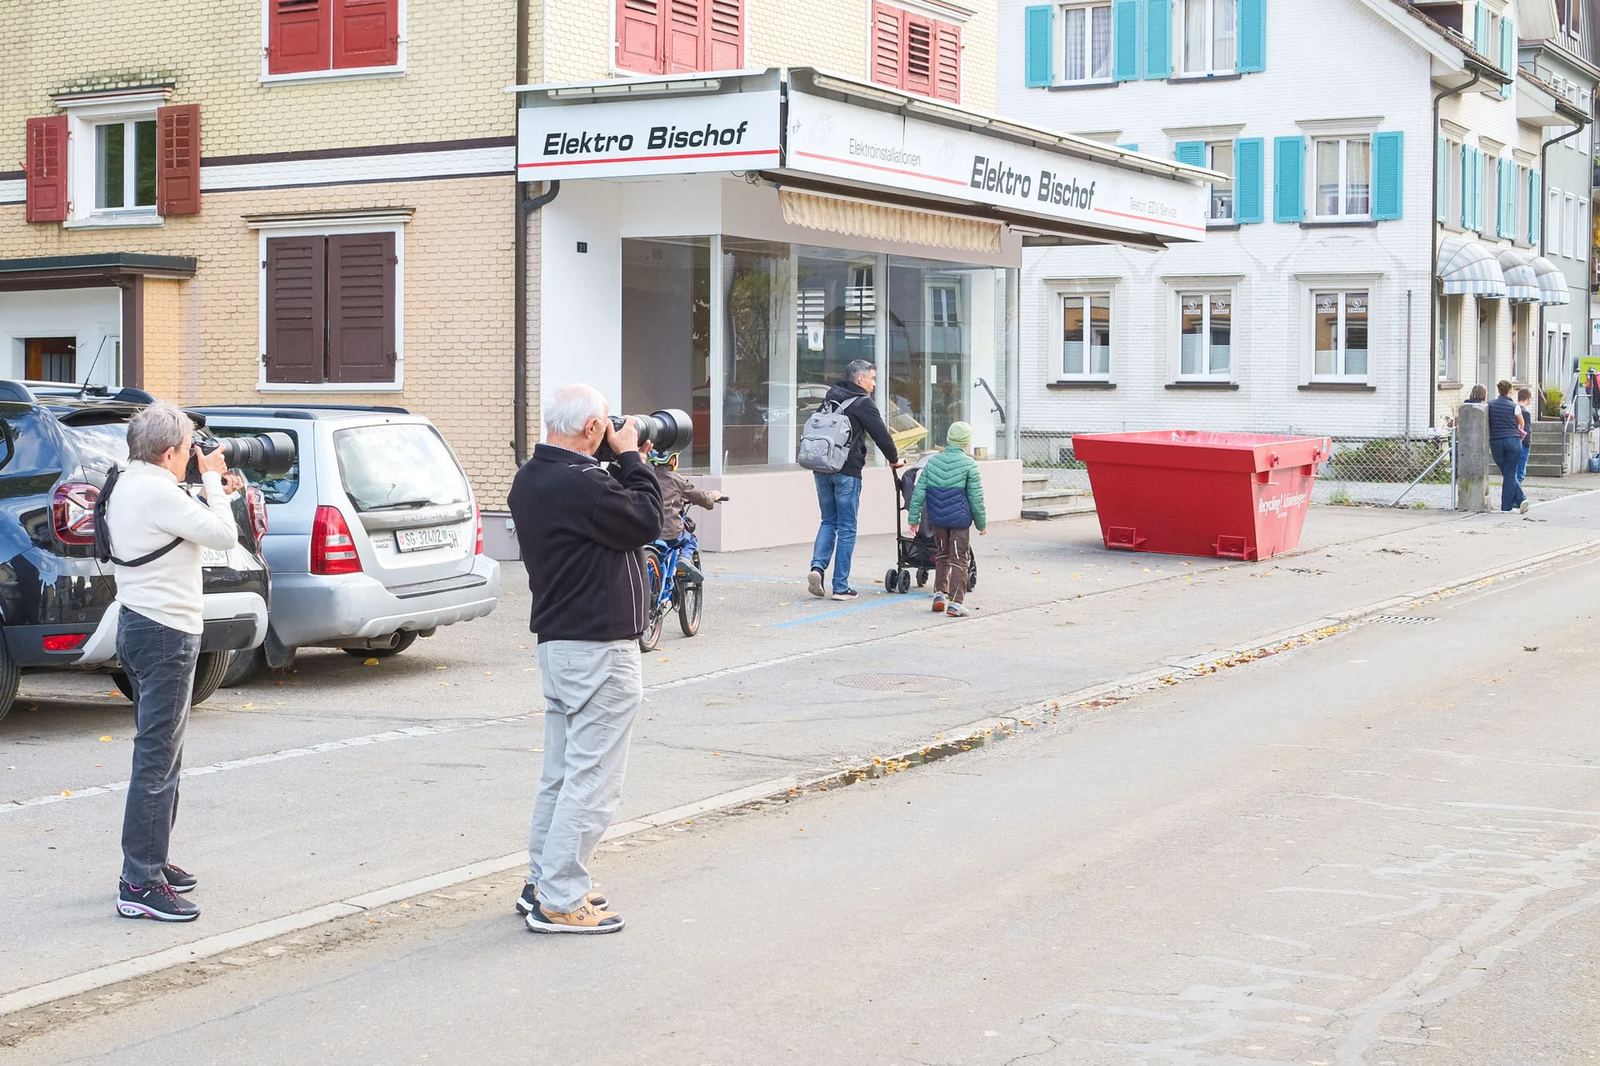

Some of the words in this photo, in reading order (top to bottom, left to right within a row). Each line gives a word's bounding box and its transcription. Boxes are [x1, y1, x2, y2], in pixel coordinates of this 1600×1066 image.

[543, 131, 633, 155] Elektro
[647, 120, 748, 150] Bischof
[970, 155, 1031, 198] Elektro
[1038, 170, 1096, 210] Bischof
